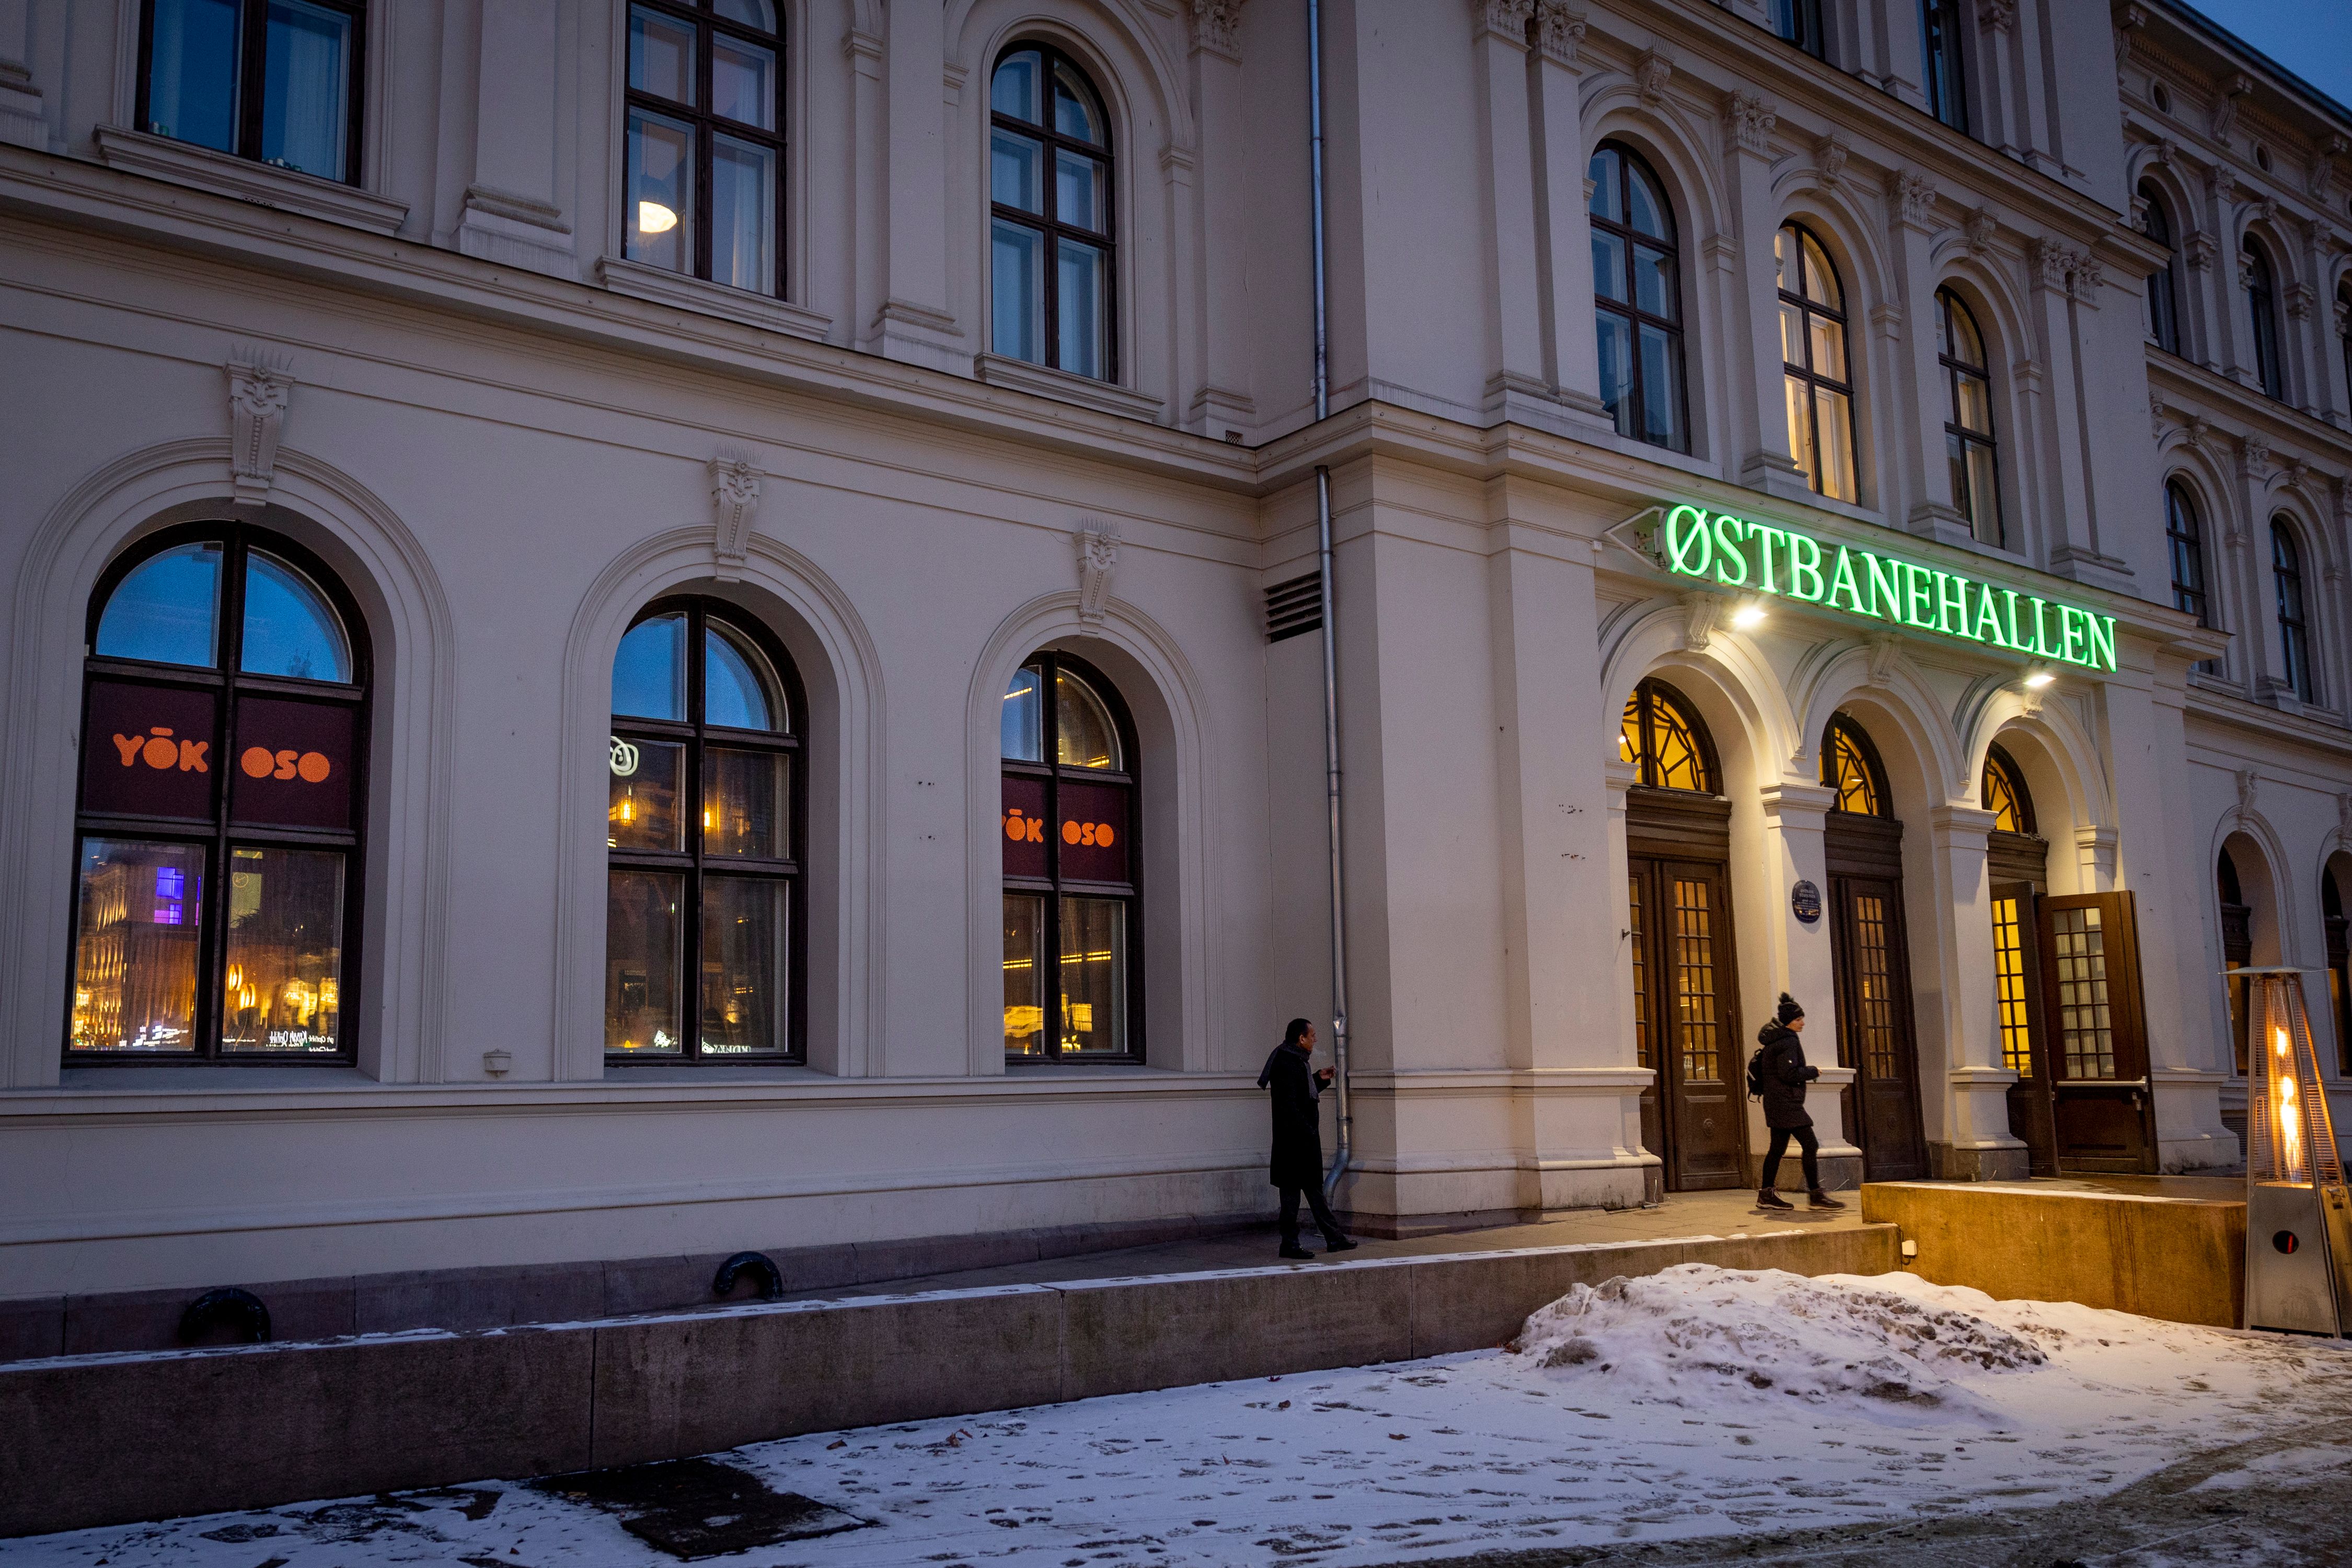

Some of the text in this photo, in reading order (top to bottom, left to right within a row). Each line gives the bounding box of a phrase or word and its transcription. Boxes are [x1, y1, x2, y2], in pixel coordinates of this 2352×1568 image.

[1666, 504, 2117, 673] ØSTBANEHALLEN
[113, 727, 330, 783] YŌK OSO
[1002, 809, 1114, 847] ŌK OSO
